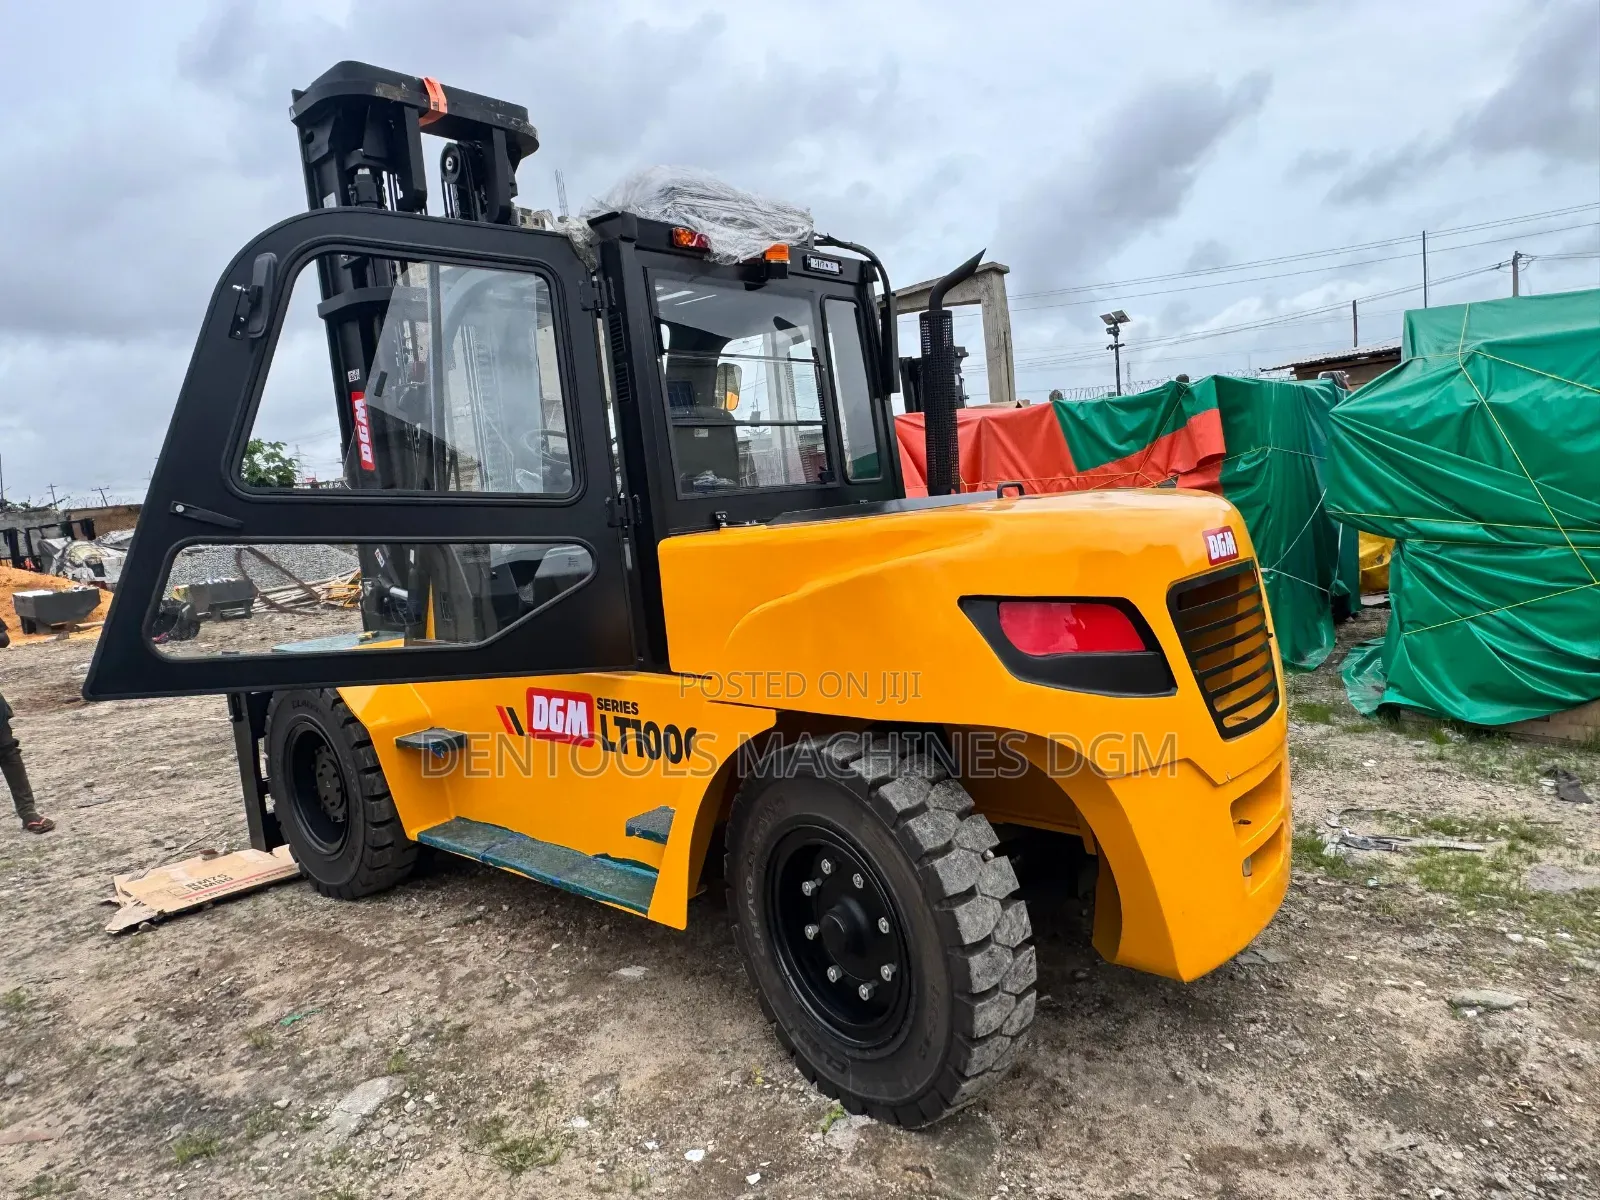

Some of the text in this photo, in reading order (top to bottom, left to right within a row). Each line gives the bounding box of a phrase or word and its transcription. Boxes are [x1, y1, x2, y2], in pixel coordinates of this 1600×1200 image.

[354, 399, 372, 463] DGM
[1206, 531, 1237, 560] DGM
[532, 695, 589, 738] DGM
[596, 697, 639, 716] SERIES
